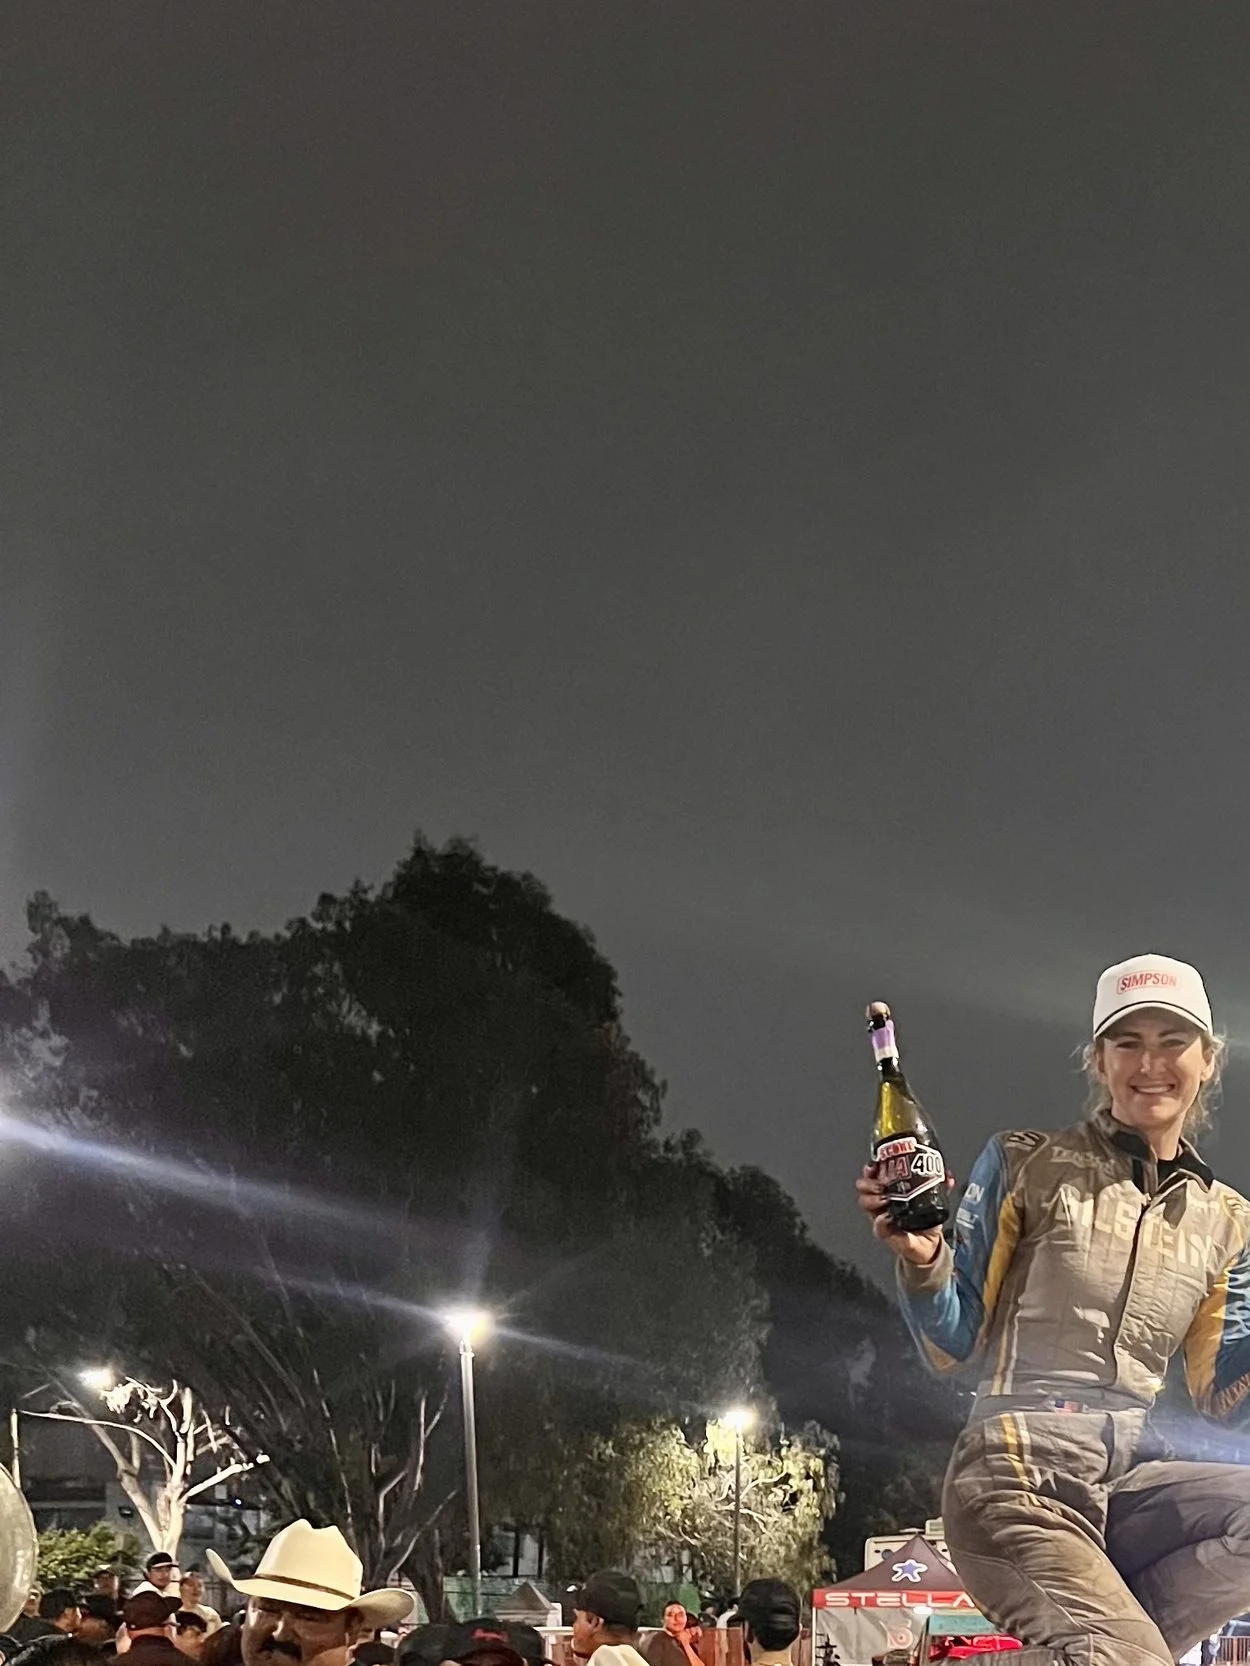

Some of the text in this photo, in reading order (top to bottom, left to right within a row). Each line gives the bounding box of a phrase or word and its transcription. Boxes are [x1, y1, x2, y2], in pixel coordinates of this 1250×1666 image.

[1120, 972, 1178, 992] SIMPSON
[911, 1152, 945, 1178] 400
[825, 1592, 975, 1608] STELLA
